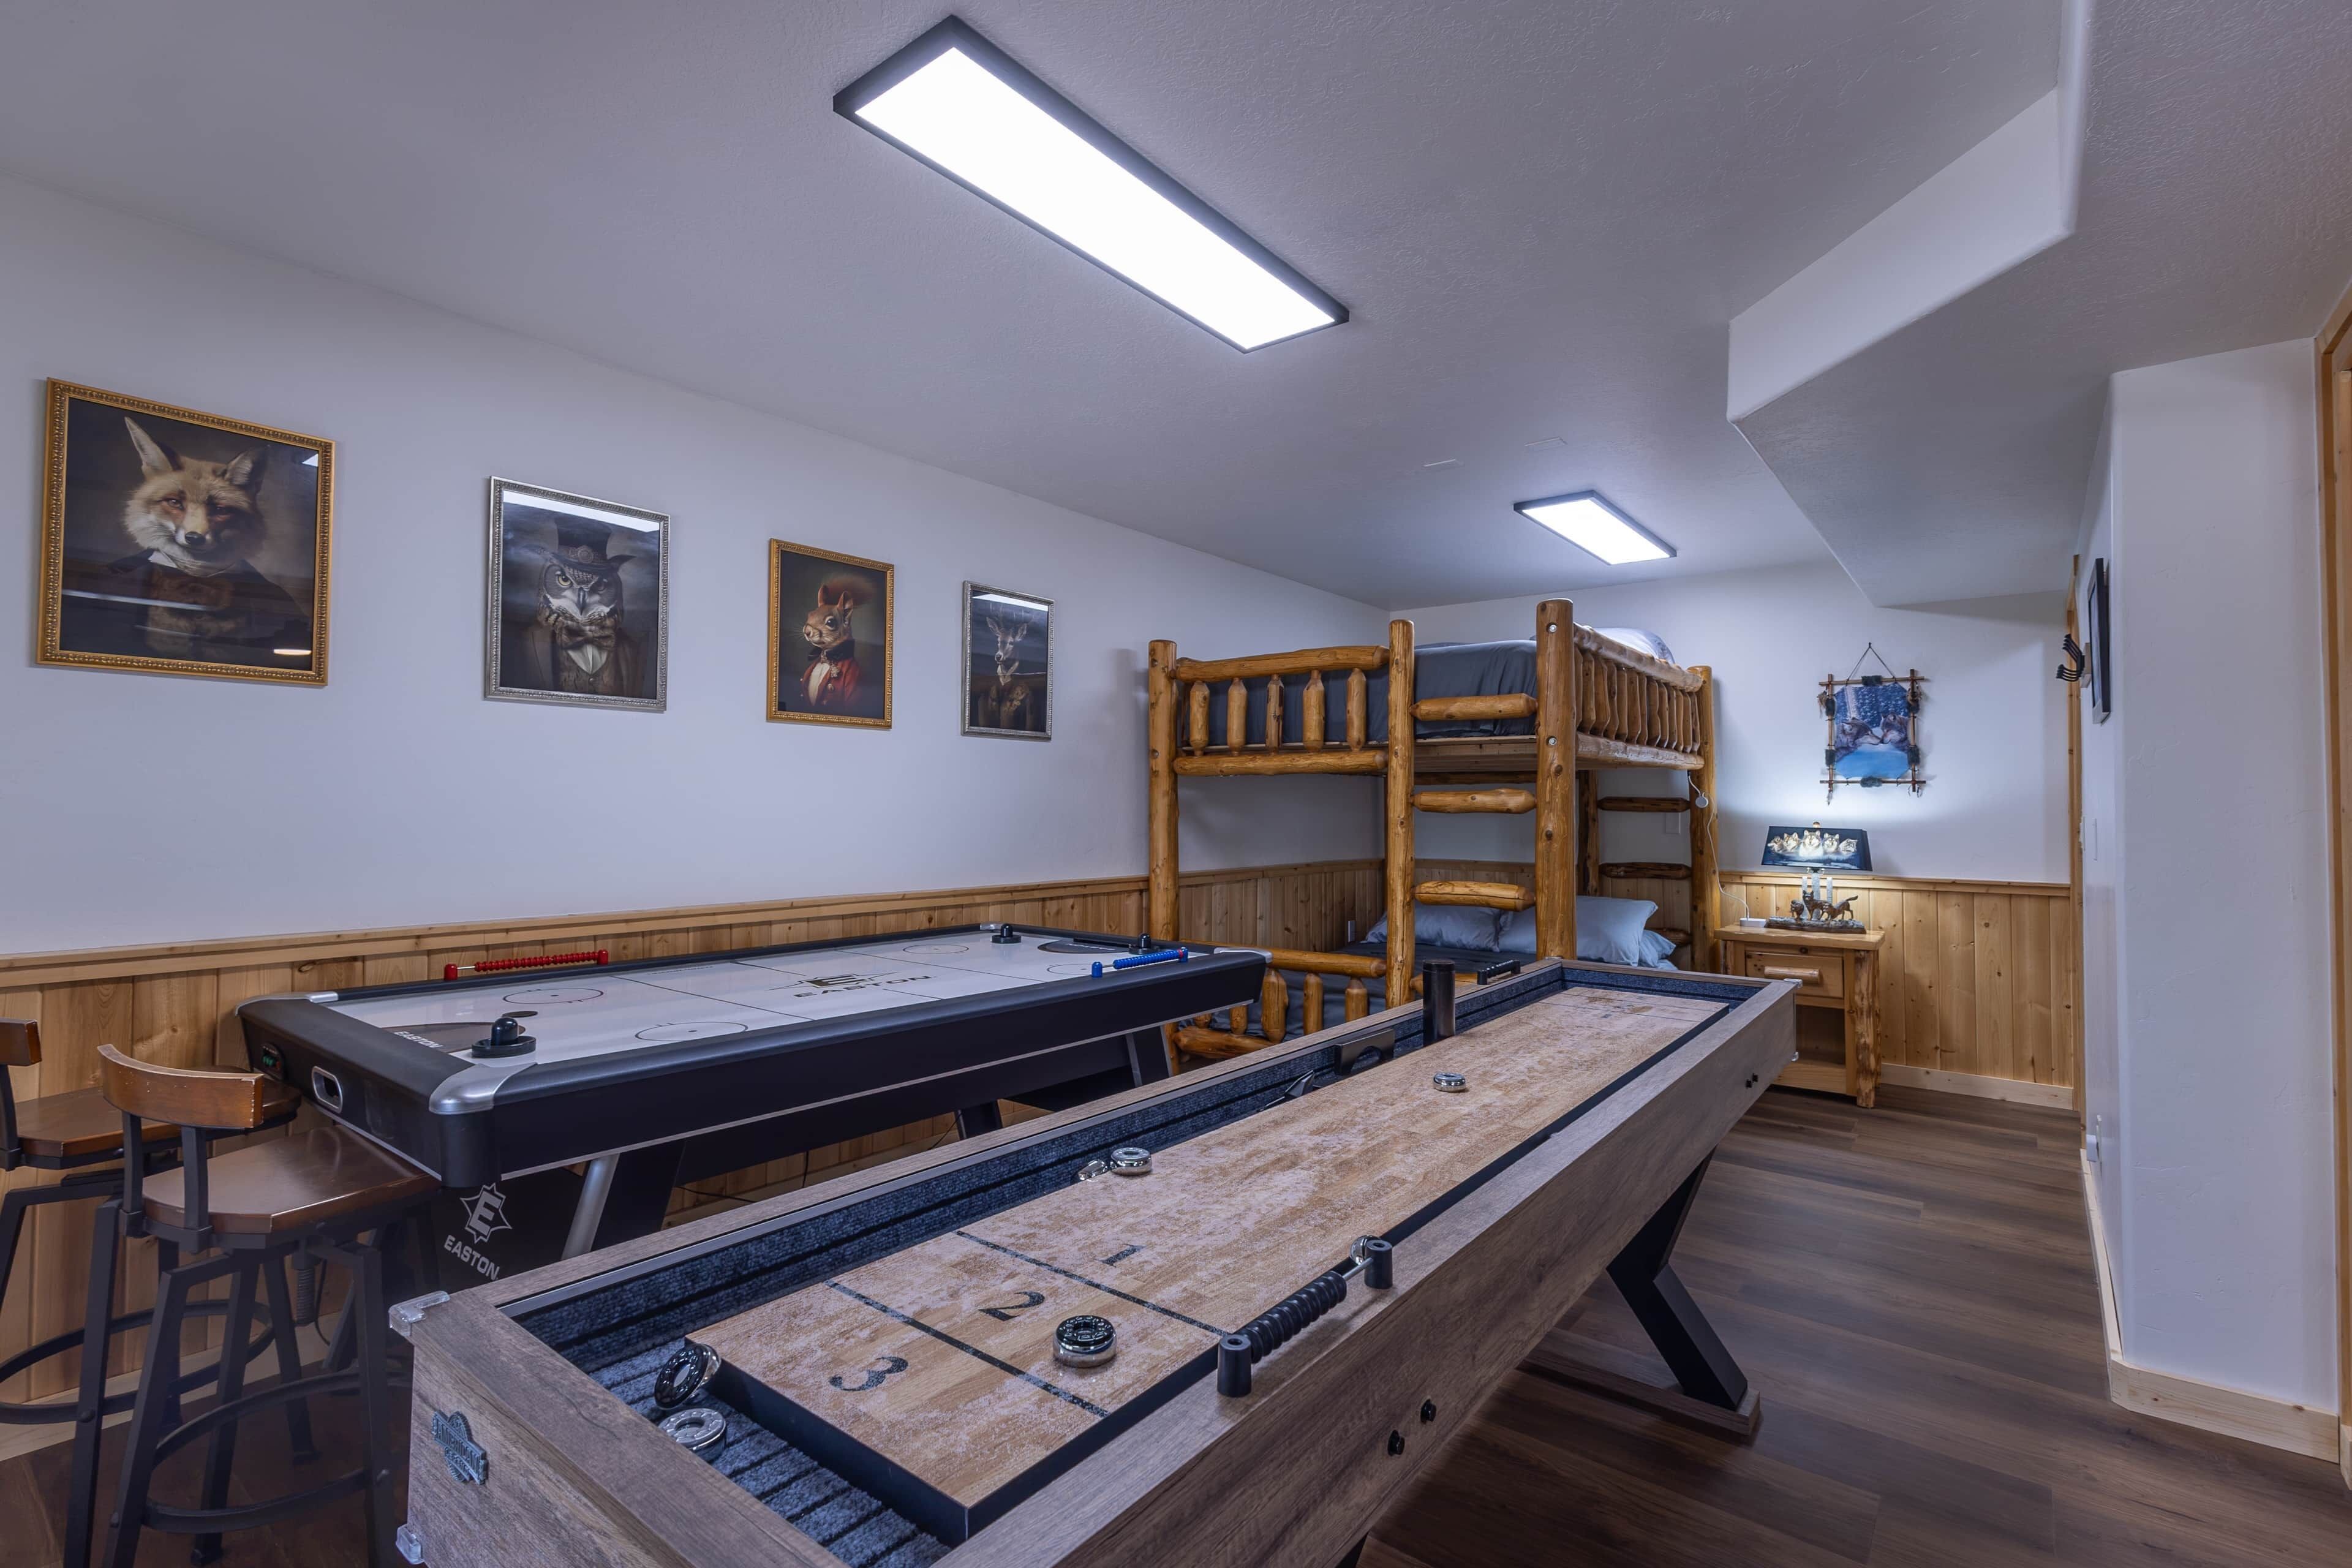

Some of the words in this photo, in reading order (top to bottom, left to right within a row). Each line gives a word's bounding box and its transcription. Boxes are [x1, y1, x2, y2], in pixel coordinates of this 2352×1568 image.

[793, 976, 932, 997] EASTON
[393, 1030, 444, 1049] EASTON
[469, 1190, 502, 1236] E
[443, 1234, 500, 1281] EASTON
[1094, 1243, 1147, 1268] 1
[978, 1290, 1046, 1322] 2
[829, 1355, 909, 1392] 3
